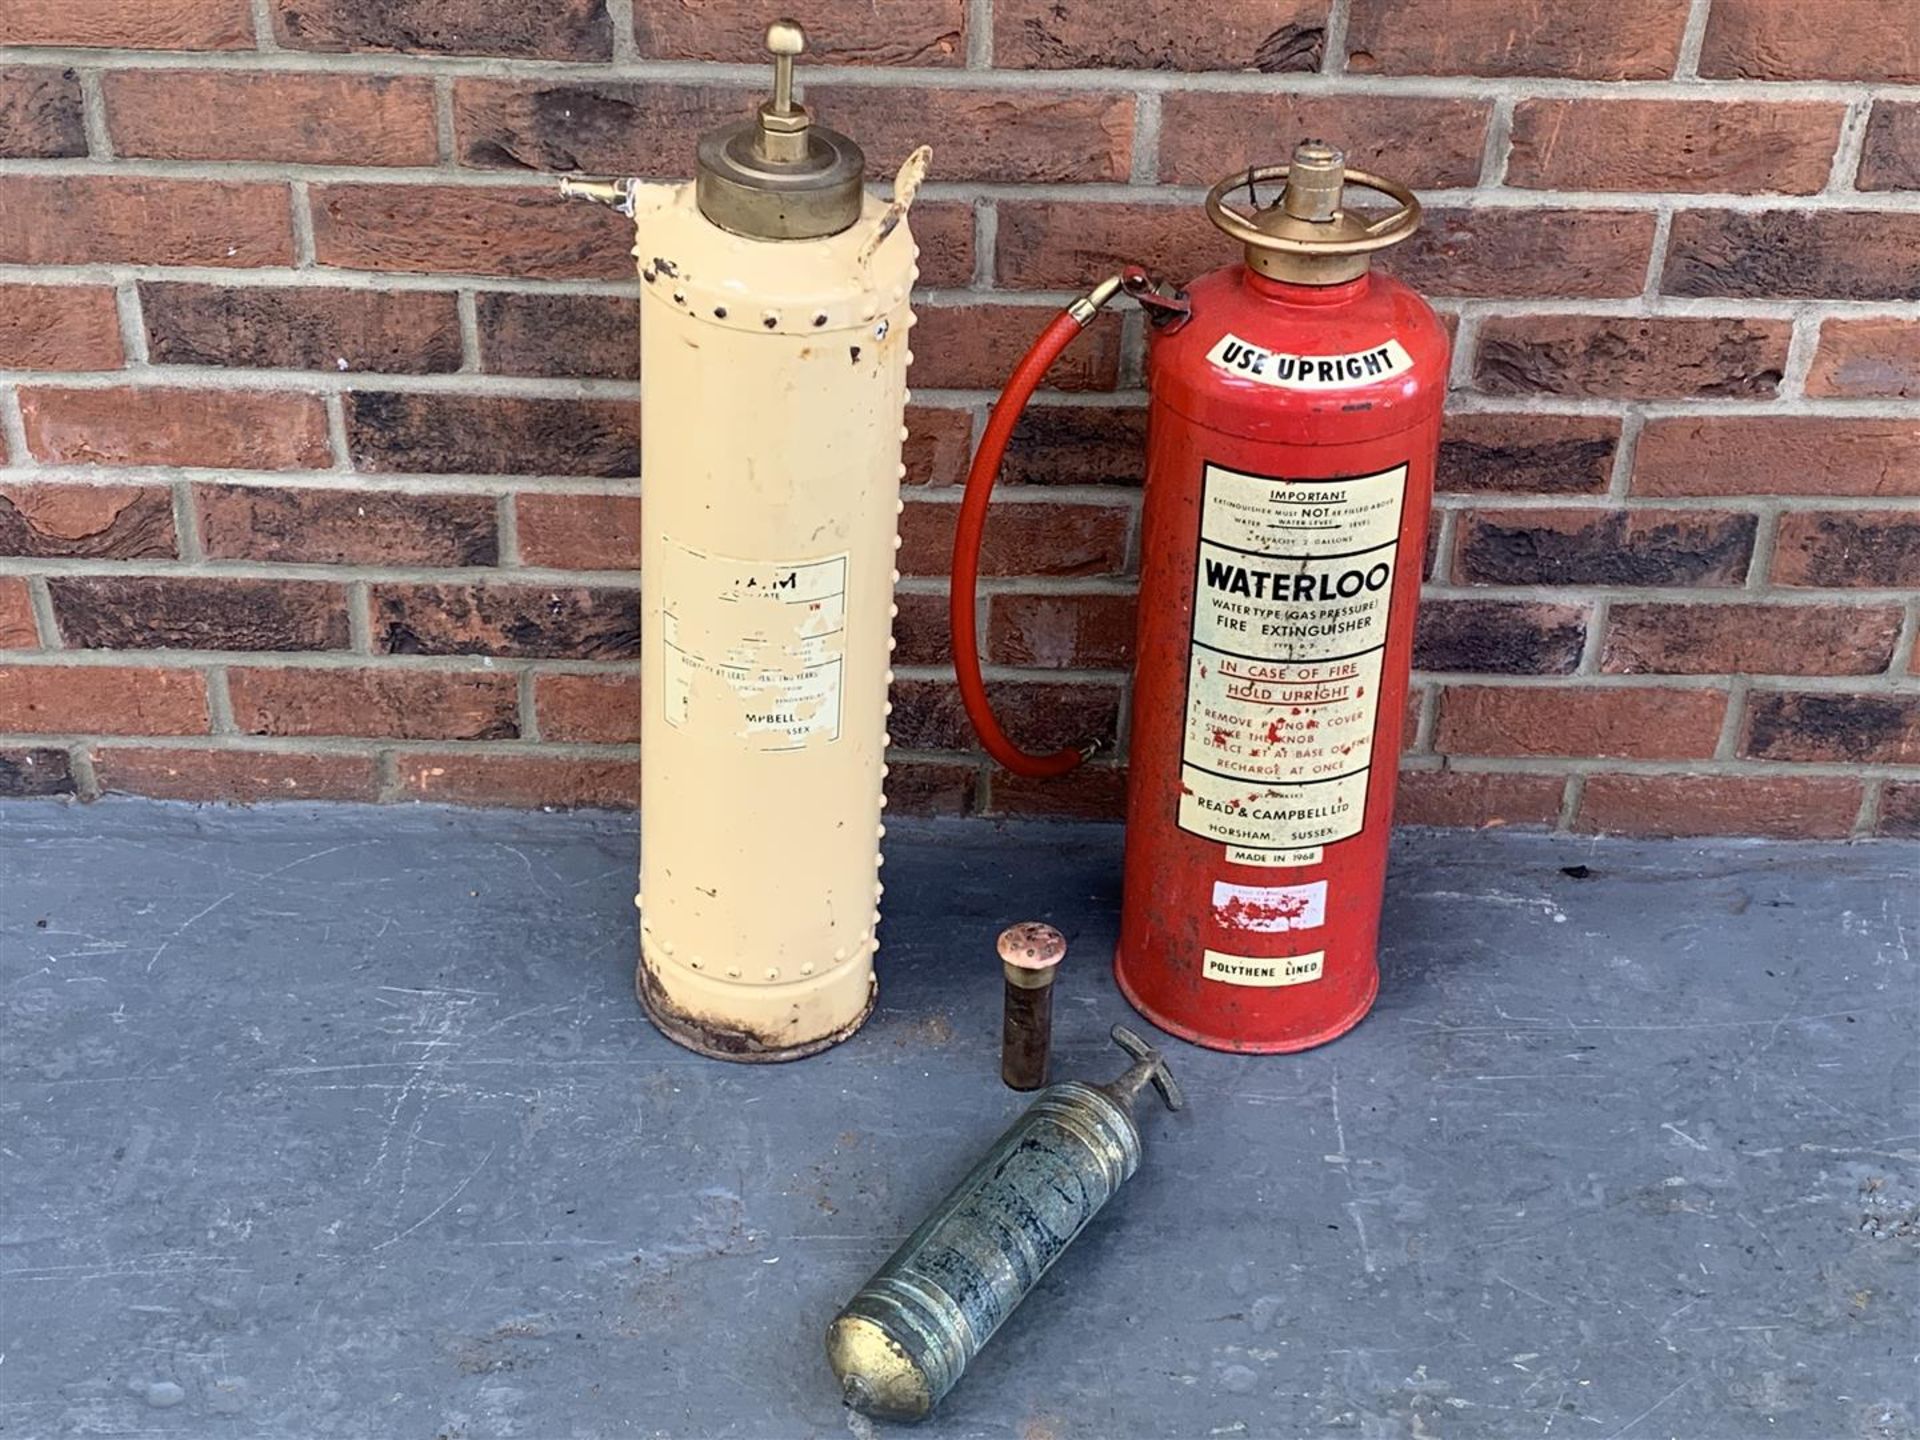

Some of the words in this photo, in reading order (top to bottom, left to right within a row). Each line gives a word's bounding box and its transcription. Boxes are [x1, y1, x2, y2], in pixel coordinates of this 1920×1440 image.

[1222, 342, 1268, 375] USE
[1277, 348, 1393, 382] UPRIGHT
[1270, 490, 1346, 501] IMPORTANT
[1301, 508, 1330, 518] NOT
[1205, 558, 1390, 602] WATERLOO
[1216, 615, 1248, 632] FIRE
[1261, 616, 1372, 637] EXTINGUISHER
[1220, 660, 1237, 673] IN
[1248, 666, 1286, 680] CASE
[1297, 668, 1319, 680] OF
[1328, 663, 1358, 677] FIRE
[1228, 684, 1272, 700] HOLD
[1282, 686, 1350, 701] UPRIGHT
[1205, 708, 1252, 728] REMOVE
[1327, 711, 1363, 727] COVER
[1279, 735, 1314, 744] KNOB
[1274, 750, 1288, 758] AT
[1295, 748, 1323, 759] BASE
[1217, 759, 1280, 775] RECHARGE
[1290, 766, 1303, 774] AT
[1312, 761, 1344, 774] ONCE
[1197, 797, 1234, 816] READ
[1237, 806, 1248, 818] &
[1252, 807, 1327, 820] CAMPBELL
[1235, 852, 1266, 863] MADE
[1293, 852, 1315, 861] 1968
[1210, 961, 1276, 977] POLYTHENE
[1285, 962, 1318, 976] LINED
